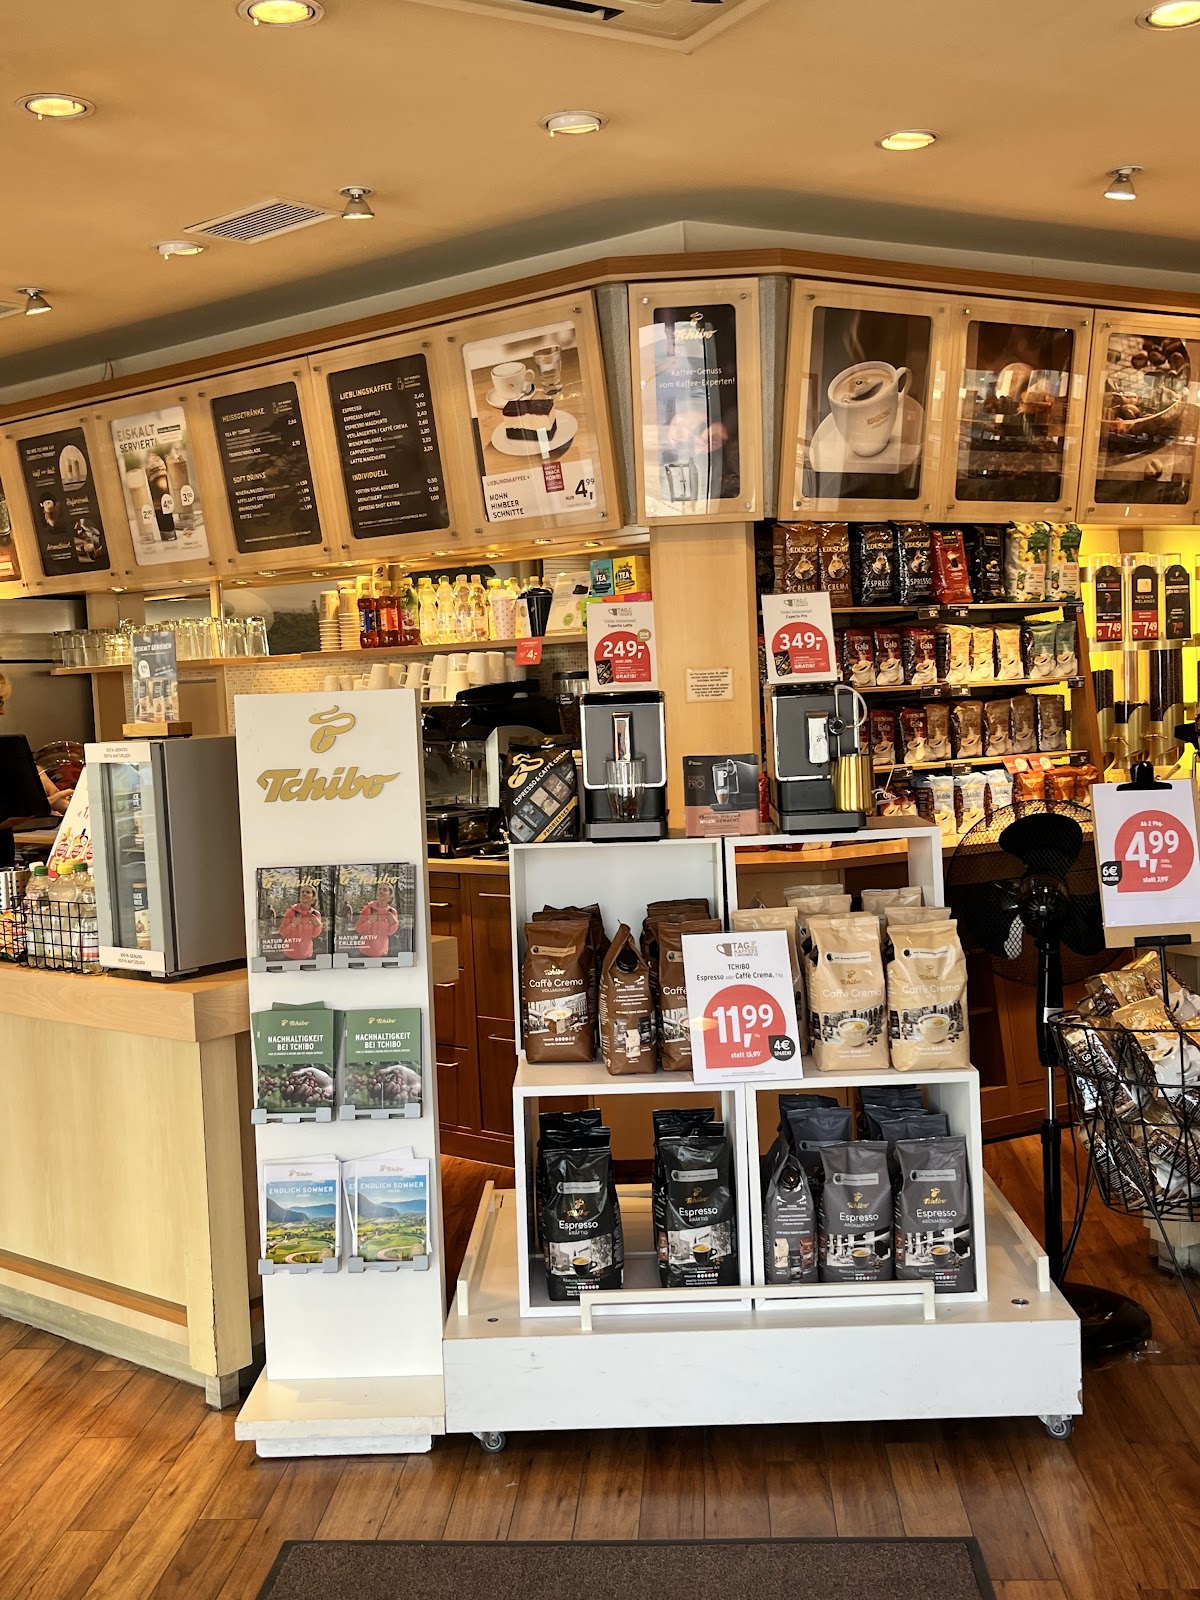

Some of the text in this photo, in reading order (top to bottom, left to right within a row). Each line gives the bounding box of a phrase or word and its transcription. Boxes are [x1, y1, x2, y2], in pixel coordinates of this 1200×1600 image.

[672, 367, 722, 377] Kaffee-Genuss
[675, 377, 736, 388] Kaffee-Experten!
[340, 382, 392, 400] LIEBLINGSKAFFEE
[222, 408, 265, 422] HEISSGETRÄNKE
[116, 424, 154, 442] EISKALT
[120, 438, 158, 452] SERVIERT!
[233, 475, 246, 484] SOFT
[352, 470, 388, 481] INDIVIDUELL
[487, 476, 526, 486] LIEBLINGSKAFFEE
[575, 478, 595, 500] 4,99
[490, 492, 508, 501] MOHN
[491, 500, 520, 510] HIMBEER
[492, 508, 524, 518] SCHNITTE
[596, 574, 606, 582] TEA
[618, 572, 630, 580] TEA
[1106, 622, 1121, 638] 7,49
[1142, 622, 1158, 637] 7,49
[779, 632, 822, 650] 349,-
[854, 642, 868, 650] Gala
[884, 641, 897, 649] Gala
[920, 642, 933, 650] Gala
[878, 724, 890, 732] Gala
[910, 719, 923, 728] Gala
[512, 780, 537, 806] ESPRESSO
[553, 750, 570, 764] CREMA
[256, 766, 400, 802] Tchibo
[544, 808, 570, 836] PROBIERSET
[1152, 820, 1164, 828] Pkg.
[1124, 830, 1179, 874] 4,99
[1102, 866, 1118, 876] 6€
[280, 876, 322, 888] Tchibo
[357, 873, 400, 884] Tchibo
[732, 942, 750, 950] TAG
[696, 974, 724, 982] Espresso
[736, 972, 752, 980] Caffè
[529, 978, 584, 988] Caffè Crema
[822, 989, 882, 998] Caffè Crema
[930, 984, 960, 993] Crema
[712, 1004, 774, 1048] 11,99
[268, 1034, 324, 1043] NACHHALTIGKEIT
[356, 1032, 410, 1041] NACHHALTIGKEIT
[377, 1040, 401, 1048] TCHIBO
[774, 1040, 790, 1050] 4€
[679, 1208, 718, 1217] Espresso
[840, 1212, 878, 1222] Espresso
[916, 1208, 956, 1219] Espresso
[559, 1220, 598, 1231] Espresso
